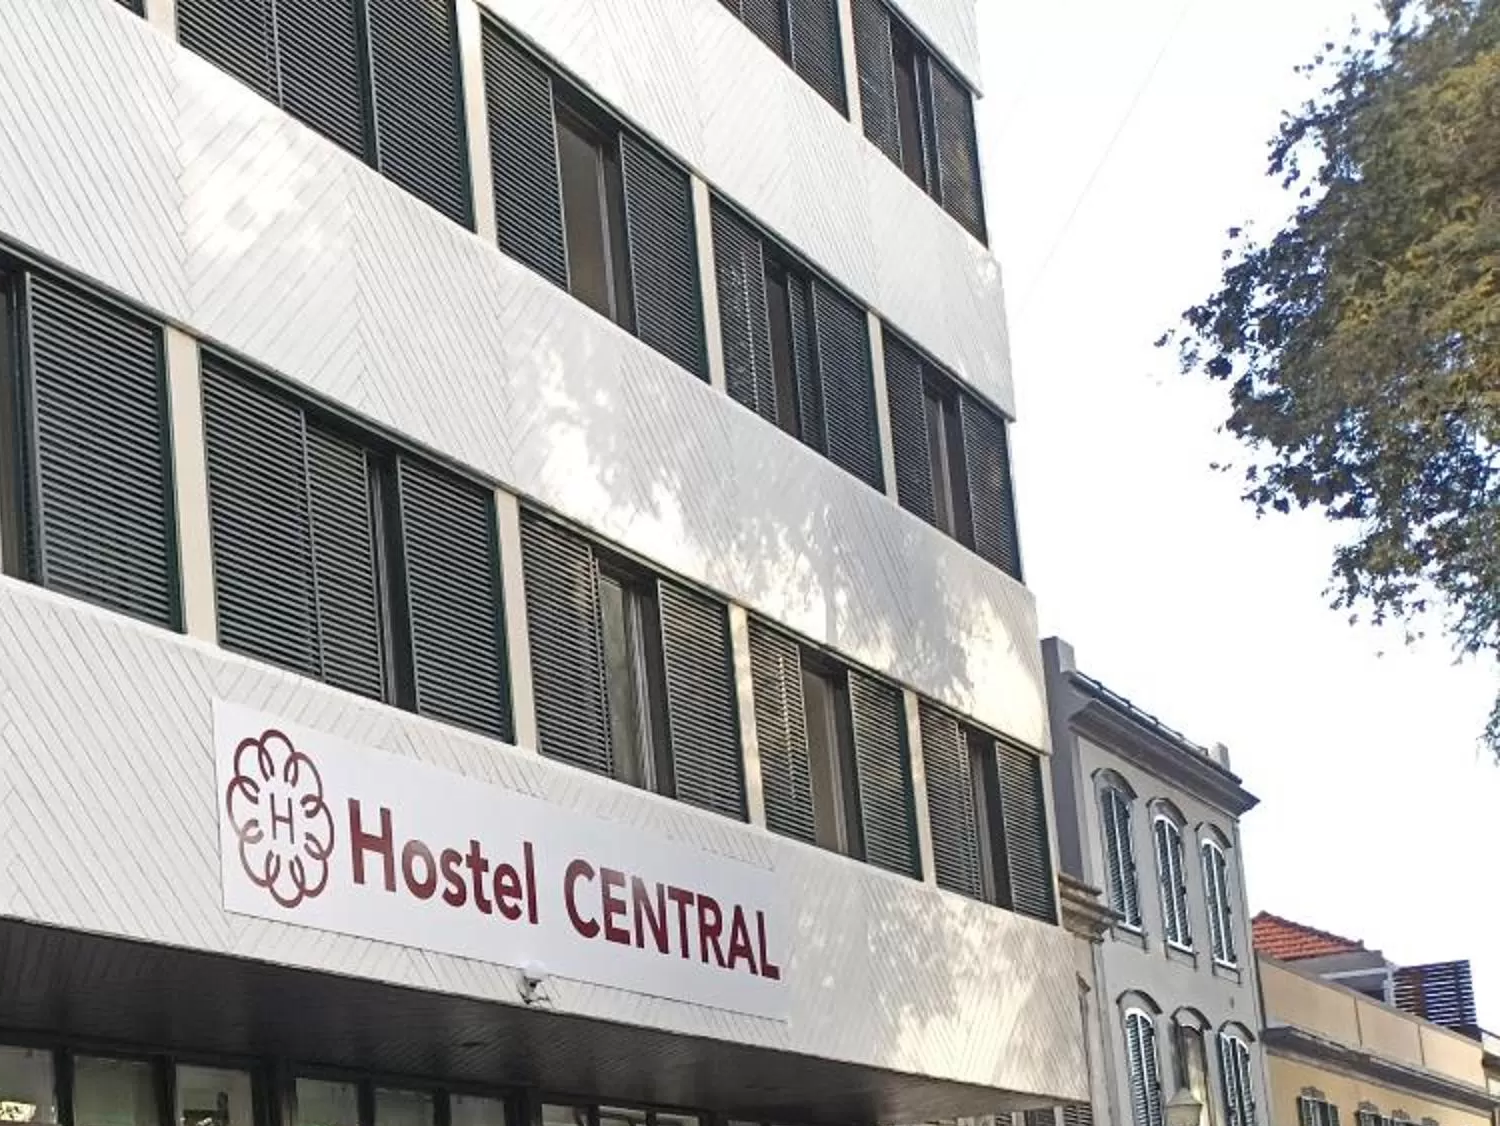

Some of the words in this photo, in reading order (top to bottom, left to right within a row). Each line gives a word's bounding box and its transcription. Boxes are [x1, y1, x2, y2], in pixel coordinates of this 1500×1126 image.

[270, 792, 295, 844] H
[348, 797, 539, 925] Hostel
[564, 859, 781, 981] CENTRAL
